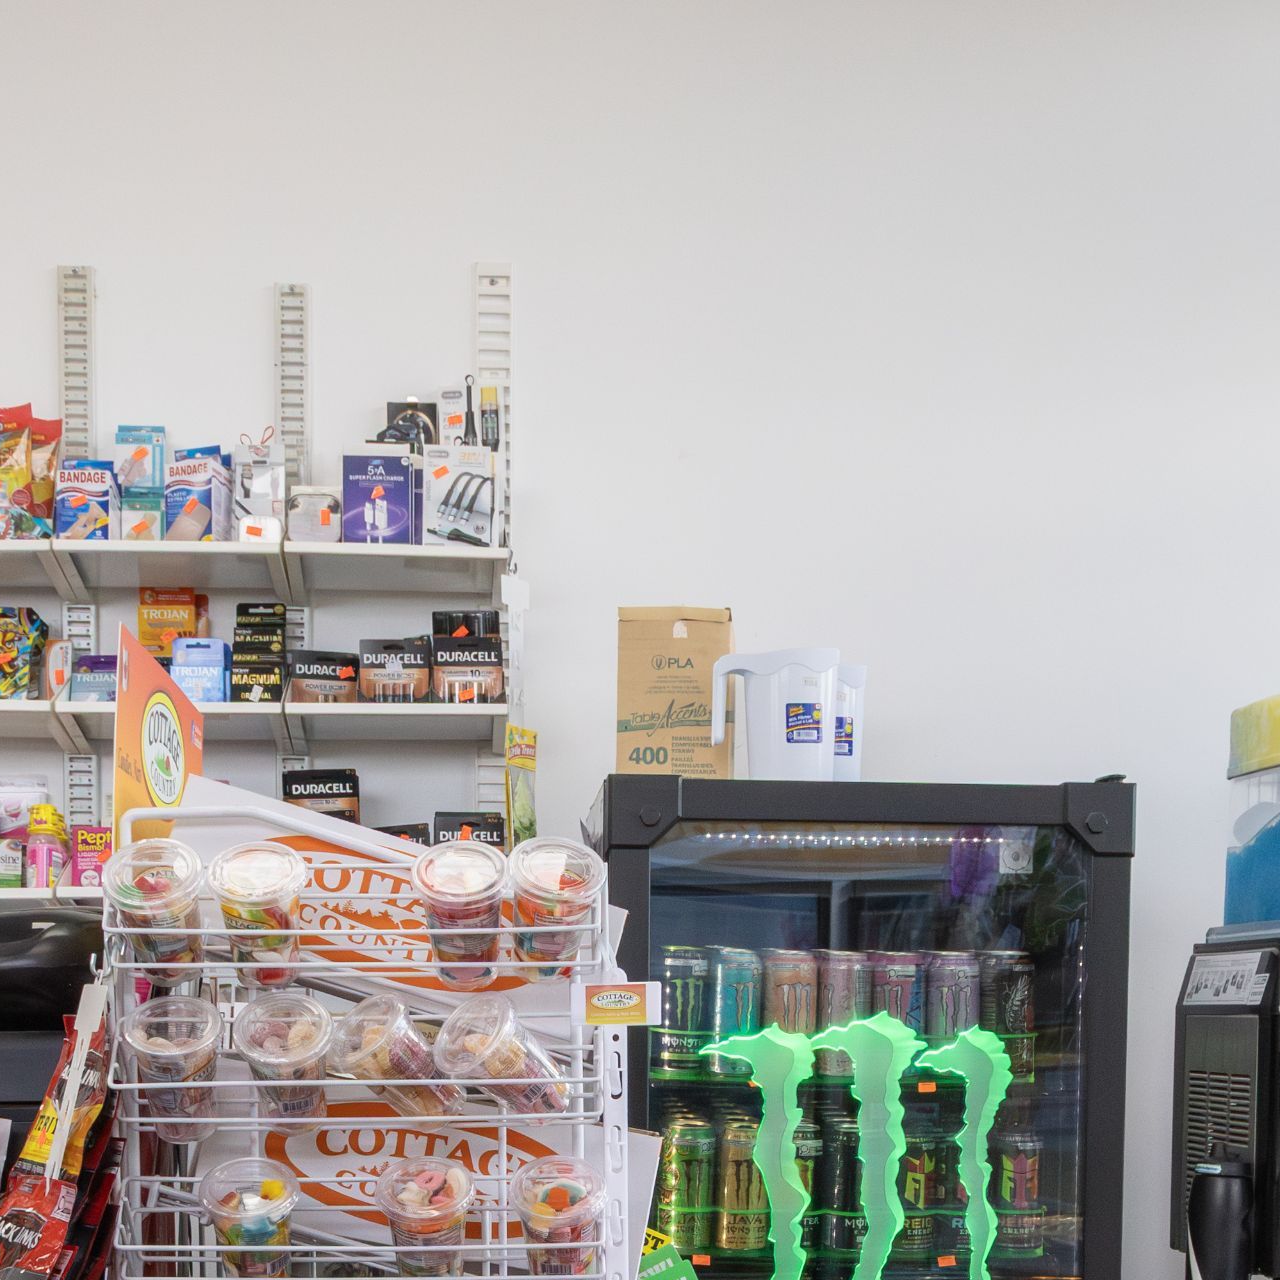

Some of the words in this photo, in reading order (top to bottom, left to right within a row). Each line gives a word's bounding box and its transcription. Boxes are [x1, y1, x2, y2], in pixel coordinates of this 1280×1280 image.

[168, 461, 209, 479] BANDAGE
[58, 470, 107, 486] BANDAGE
[142, 608, 190, 621] TROJAN
[363, 652, 425, 665] DURACELL
[437, 651, 499, 663] DURACELL
[667, 657, 694, 669] PLA
[232, 674, 282, 686] MAGNUM
[630, 712, 661, 726] Table
[148, 711, 181, 770] COTTAGE
[628, 746, 668, 765] 400
[292, 783, 354, 796] DURACELL
[77, 830, 112, 844] Pept
[596, 991, 636, 1003] COTTAGE
